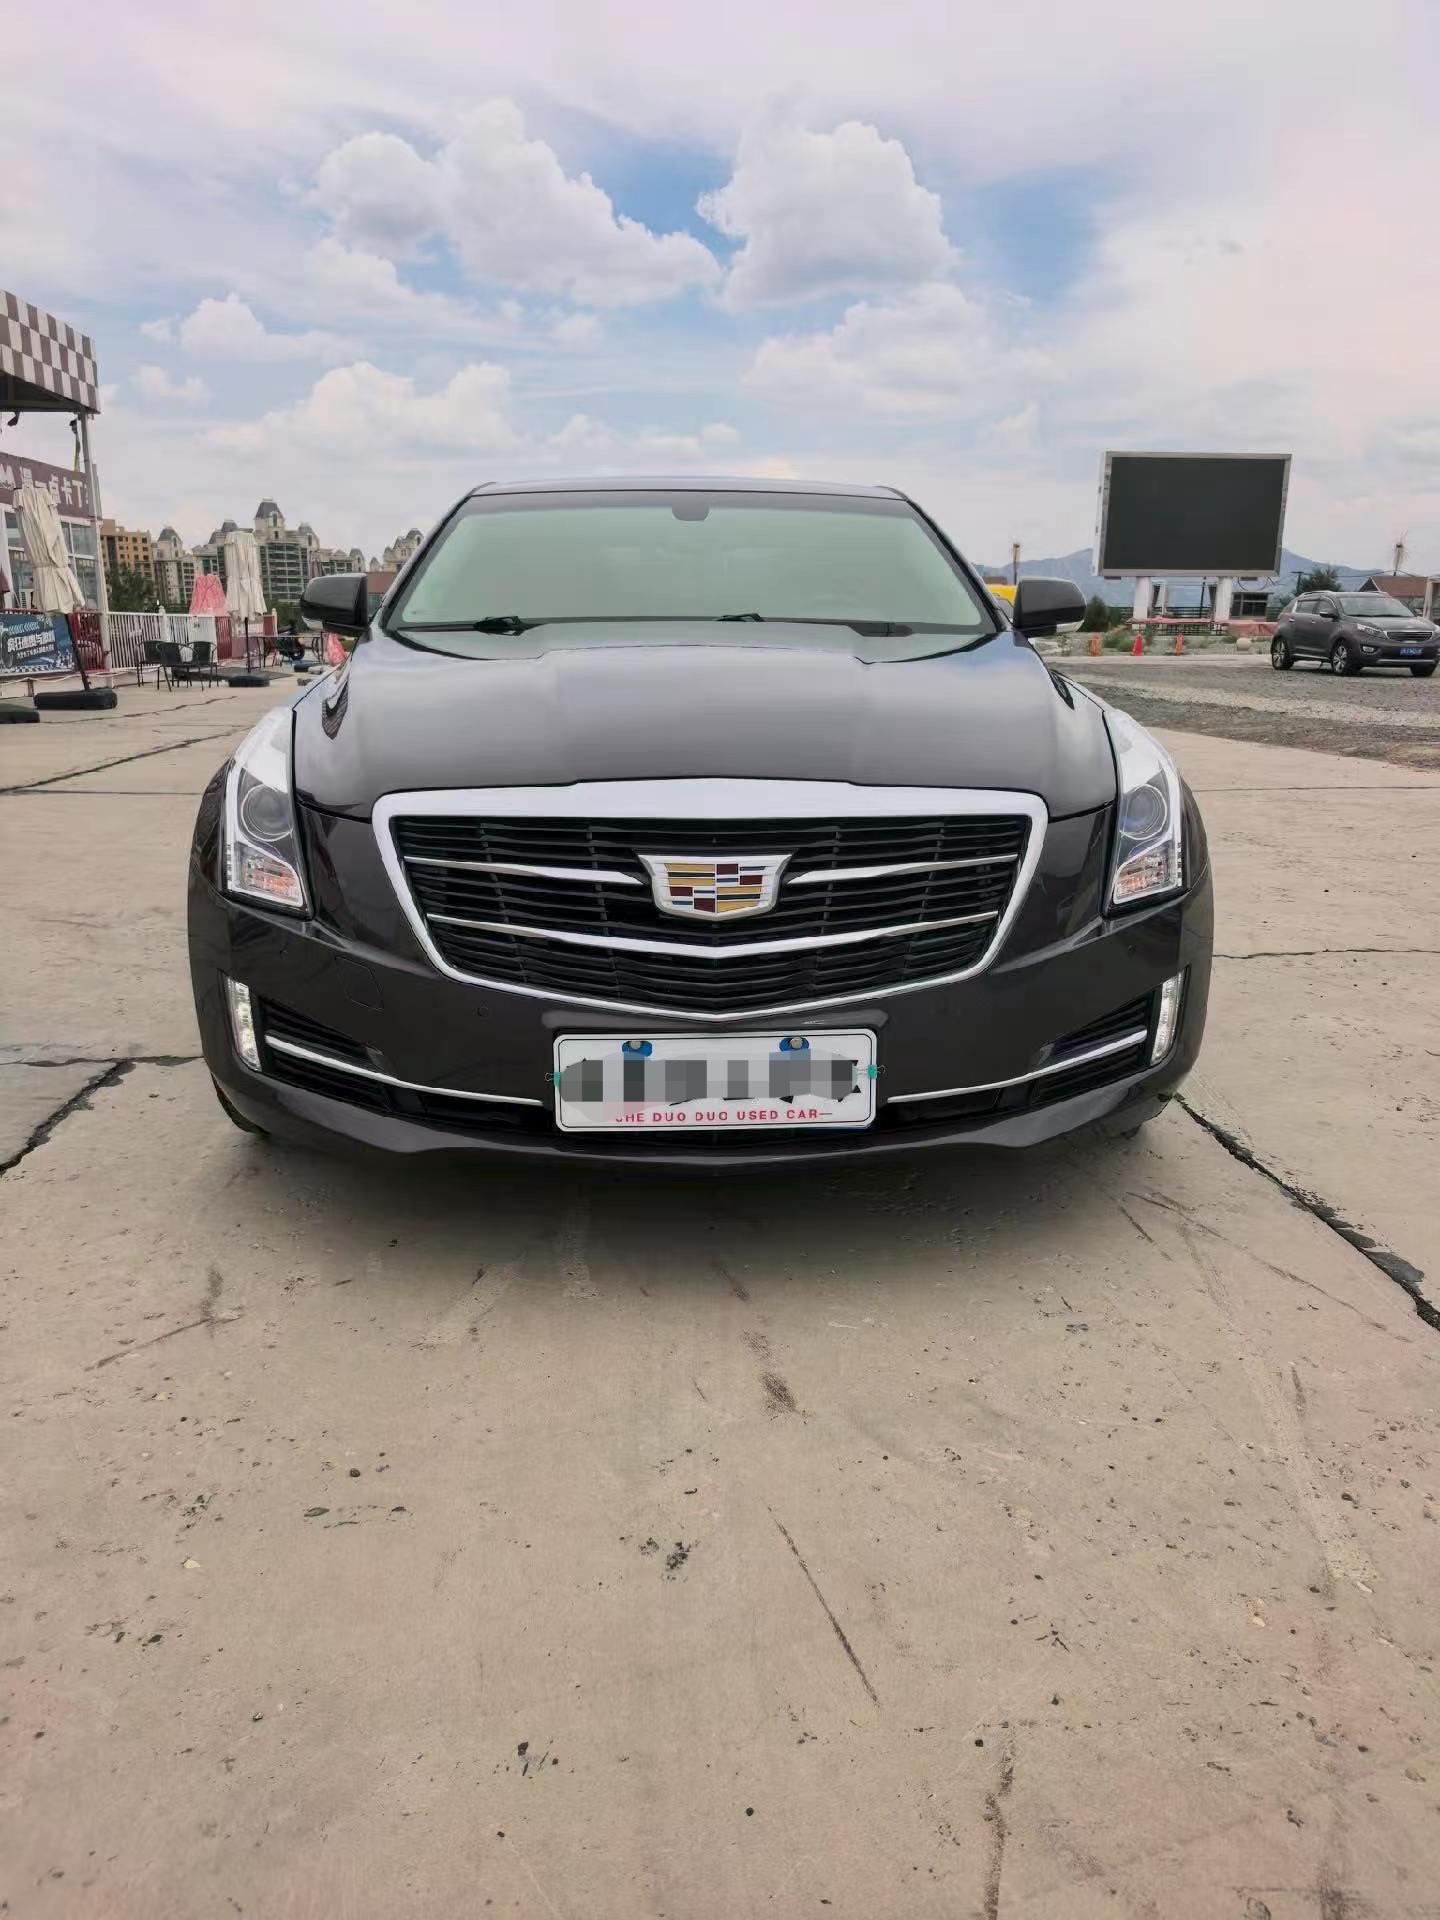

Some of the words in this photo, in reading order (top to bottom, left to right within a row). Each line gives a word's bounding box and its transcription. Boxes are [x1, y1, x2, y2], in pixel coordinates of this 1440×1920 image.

[652, 1112, 686, 1122] DUO
[695, 1111, 728, 1121] DUO
[737, 1110, 778, 1120] USED
[786, 1109, 818, 1119] CAR
